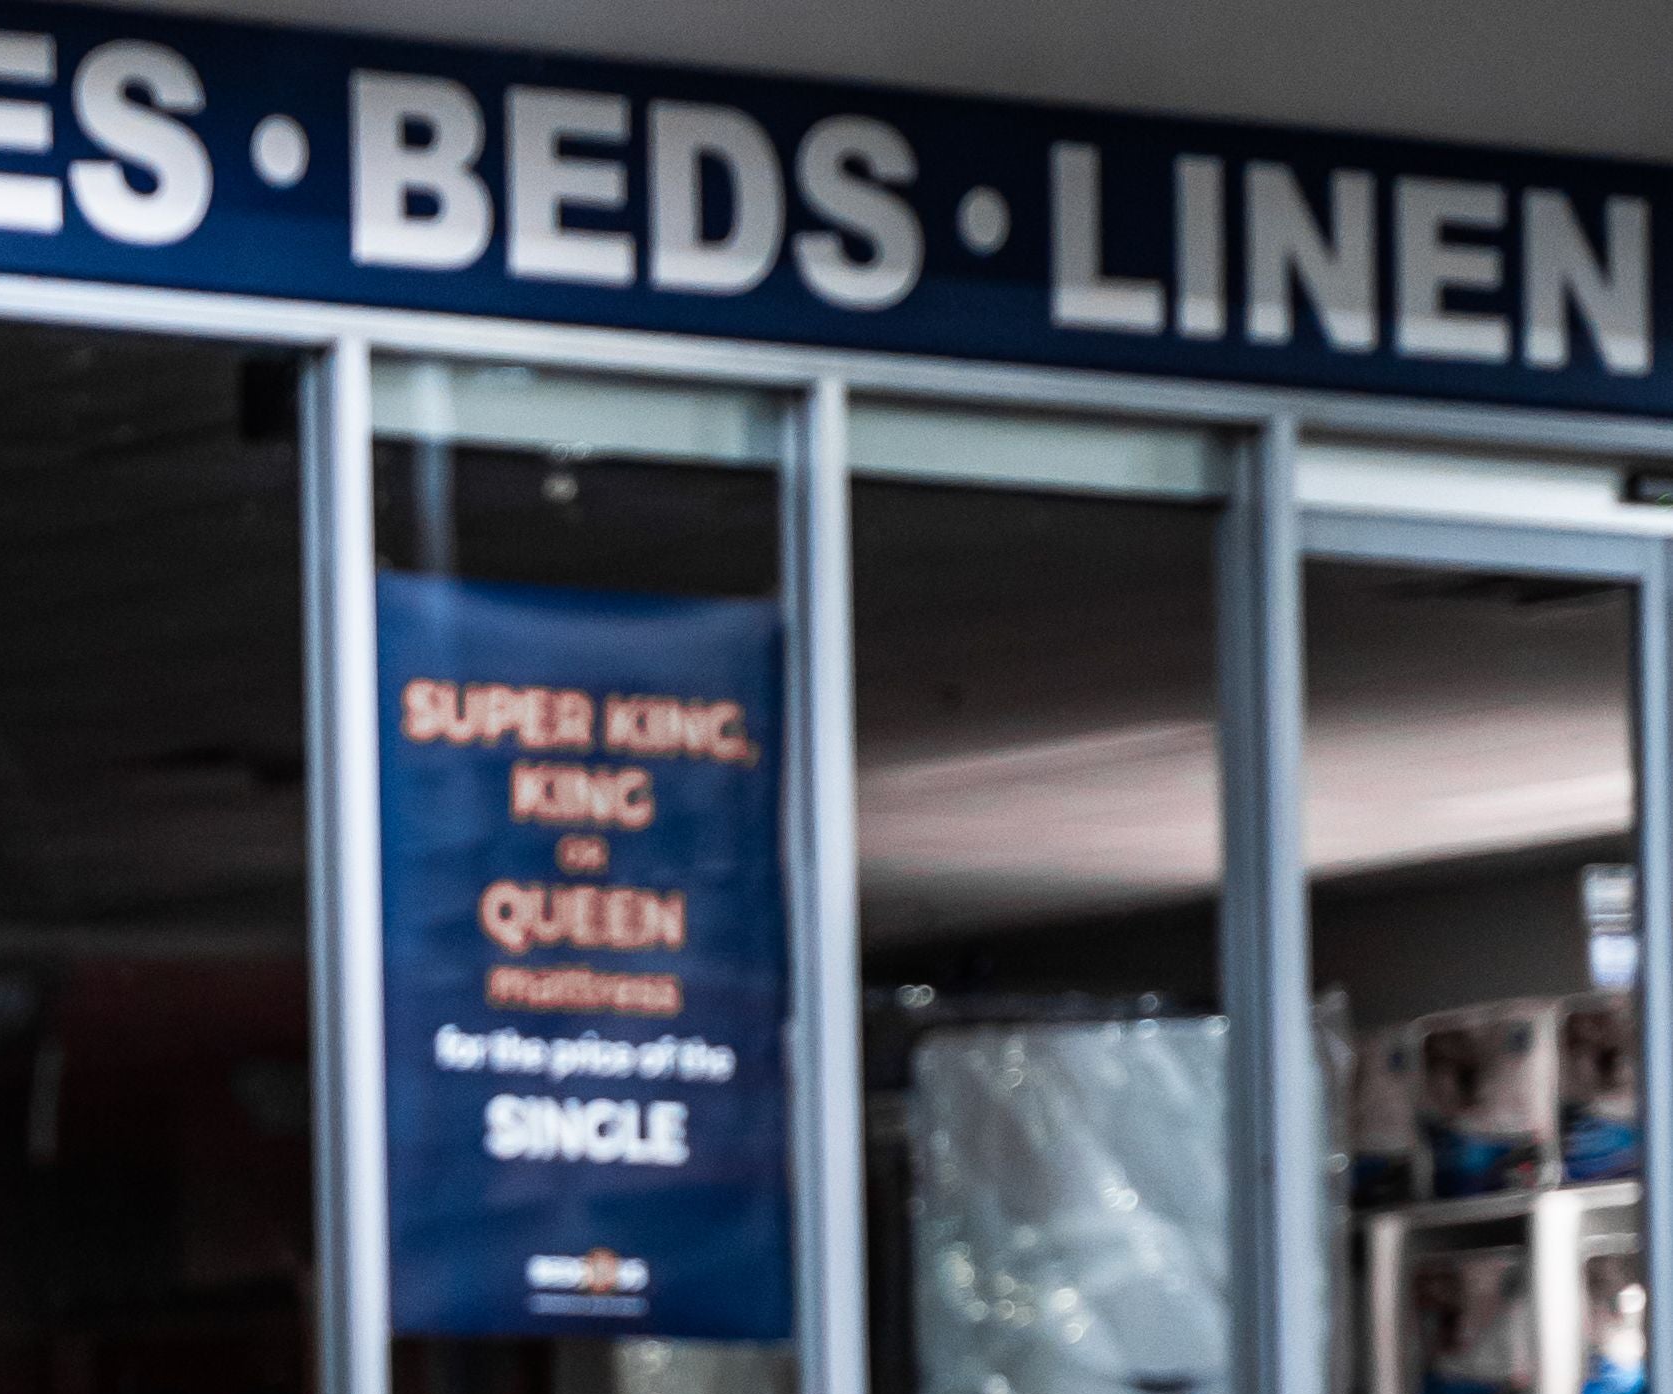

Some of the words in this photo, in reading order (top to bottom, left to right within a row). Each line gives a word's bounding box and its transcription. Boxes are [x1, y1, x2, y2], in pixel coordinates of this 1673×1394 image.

[350, 70, 924, 310] BEDS
[1051, 141, 1653, 375] LINEN
[484, 1092, 691, 1166] SINGLE
